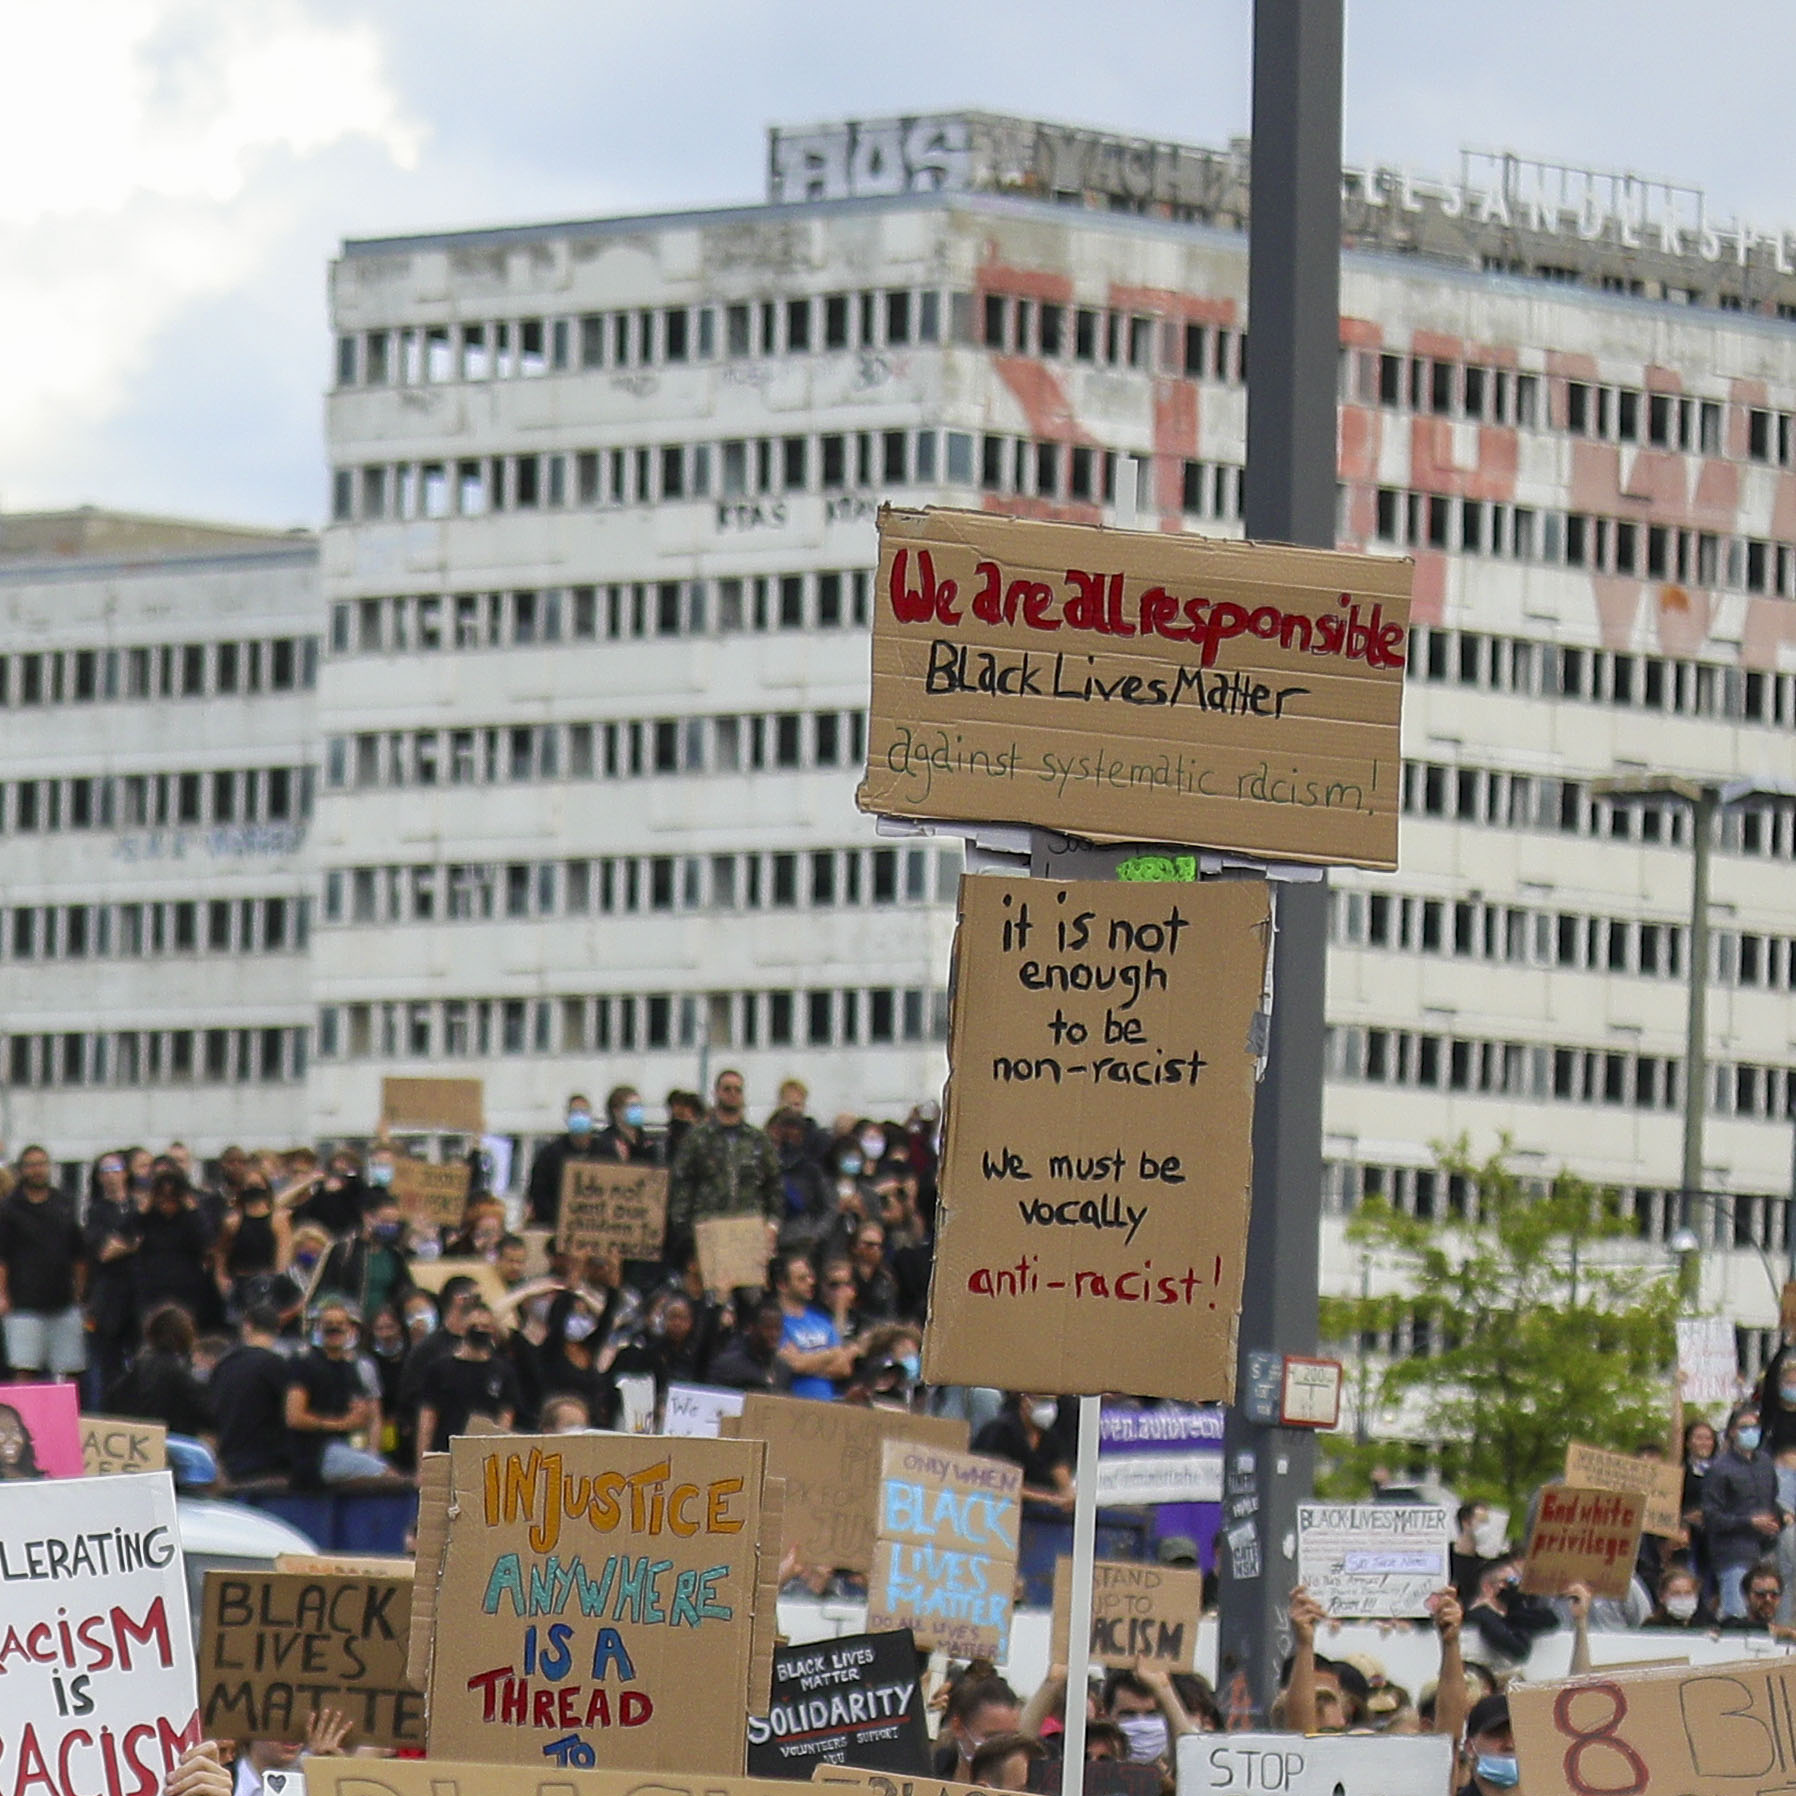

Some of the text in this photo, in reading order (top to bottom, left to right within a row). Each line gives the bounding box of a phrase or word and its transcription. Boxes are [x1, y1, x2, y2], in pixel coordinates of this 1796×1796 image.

[890, 548, 1406, 669] We are all responsible
[1055, 652, 1166, 707] Lives
[1171, 665, 1311, 719] Matter
[887, 727, 1379, 816] against systematic racism!
[1001, 890, 1189, 955] it is not
[1019, 959, 1167, 1011] enough
[1048, 1008, 1147, 1047] to be
[992, 1048, 1208, 1086] non-racist
[1049, 1148, 1126, 1182] must
[1139, 1147, 1186, 1184] be
[1019, 1195, 1149, 1246] vocally
[967, 1253, 1221, 1311] anti-racist!
[83, 1432, 150, 1464] ACK
[903, 1453, 1021, 1494] ONLY WHEN
[883, 1478, 1017, 1551] BLACK
[1541, 1494, 1635, 1529] End white
[889, 1540, 992, 1598] LIVES
[1531, 1528, 1632, 1567] privilege
[215, 1580, 400, 1640] BLACK
[480, 1552, 734, 1629] ANYWHERE
[212, 1633, 368, 1680] LIVES
[523, 1624, 637, 1683] IS A
[776, 1649, 874, 1682] BLACK LIVES
[800, 1667, 861, 1691] MATTER
[466, 1665, 654, 1729] THREAD
[748, 1683, 915, 1746] SOLIDARITY
[542, 1733, 597, 1771] TO
[779, 1725, 901, 1758] VOLUNTEERS SUPPORT
[1209, 1746, 1305, 1793] STOP
